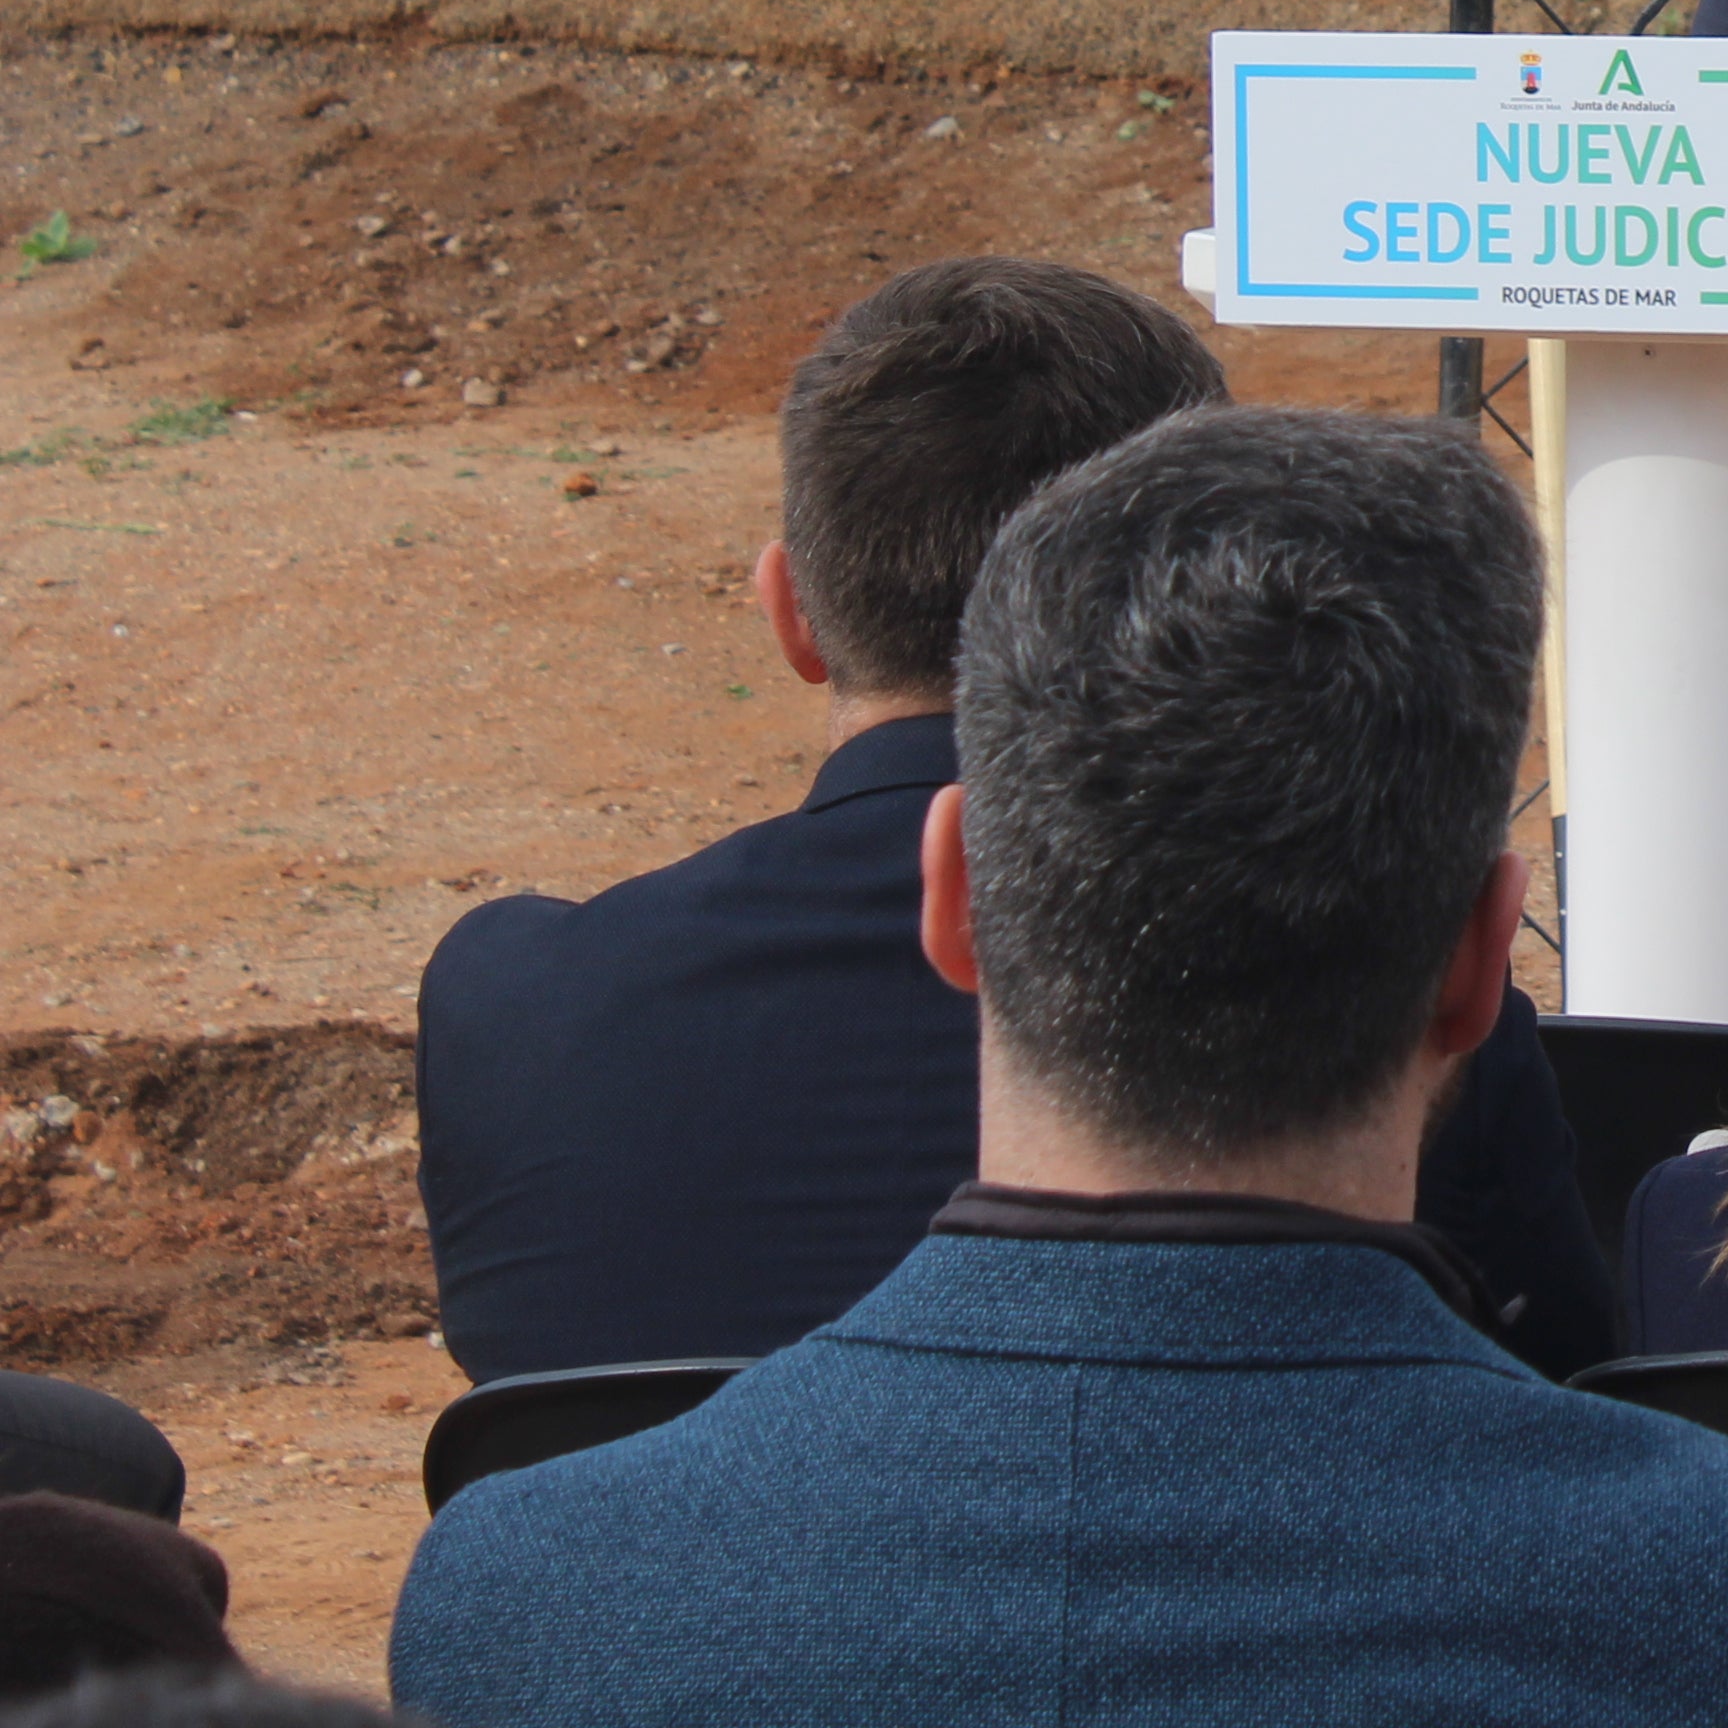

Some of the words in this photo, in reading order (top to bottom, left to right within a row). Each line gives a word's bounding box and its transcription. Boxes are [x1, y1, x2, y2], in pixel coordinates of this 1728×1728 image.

[1572, 100, 1604, 112] Junta
[1605, 100, 1619, 112] de
[1621, 99, 1676, 113] Andalucía
[1476, 121, 1705, 186] NUEVA
[1341, 199, 1513, 265] SEDE
[1501, 285, 1600, 308] ROQUETAS
[1605, 286, 1630, 307] DE
[1634, 287, 1677, 308] MAR
